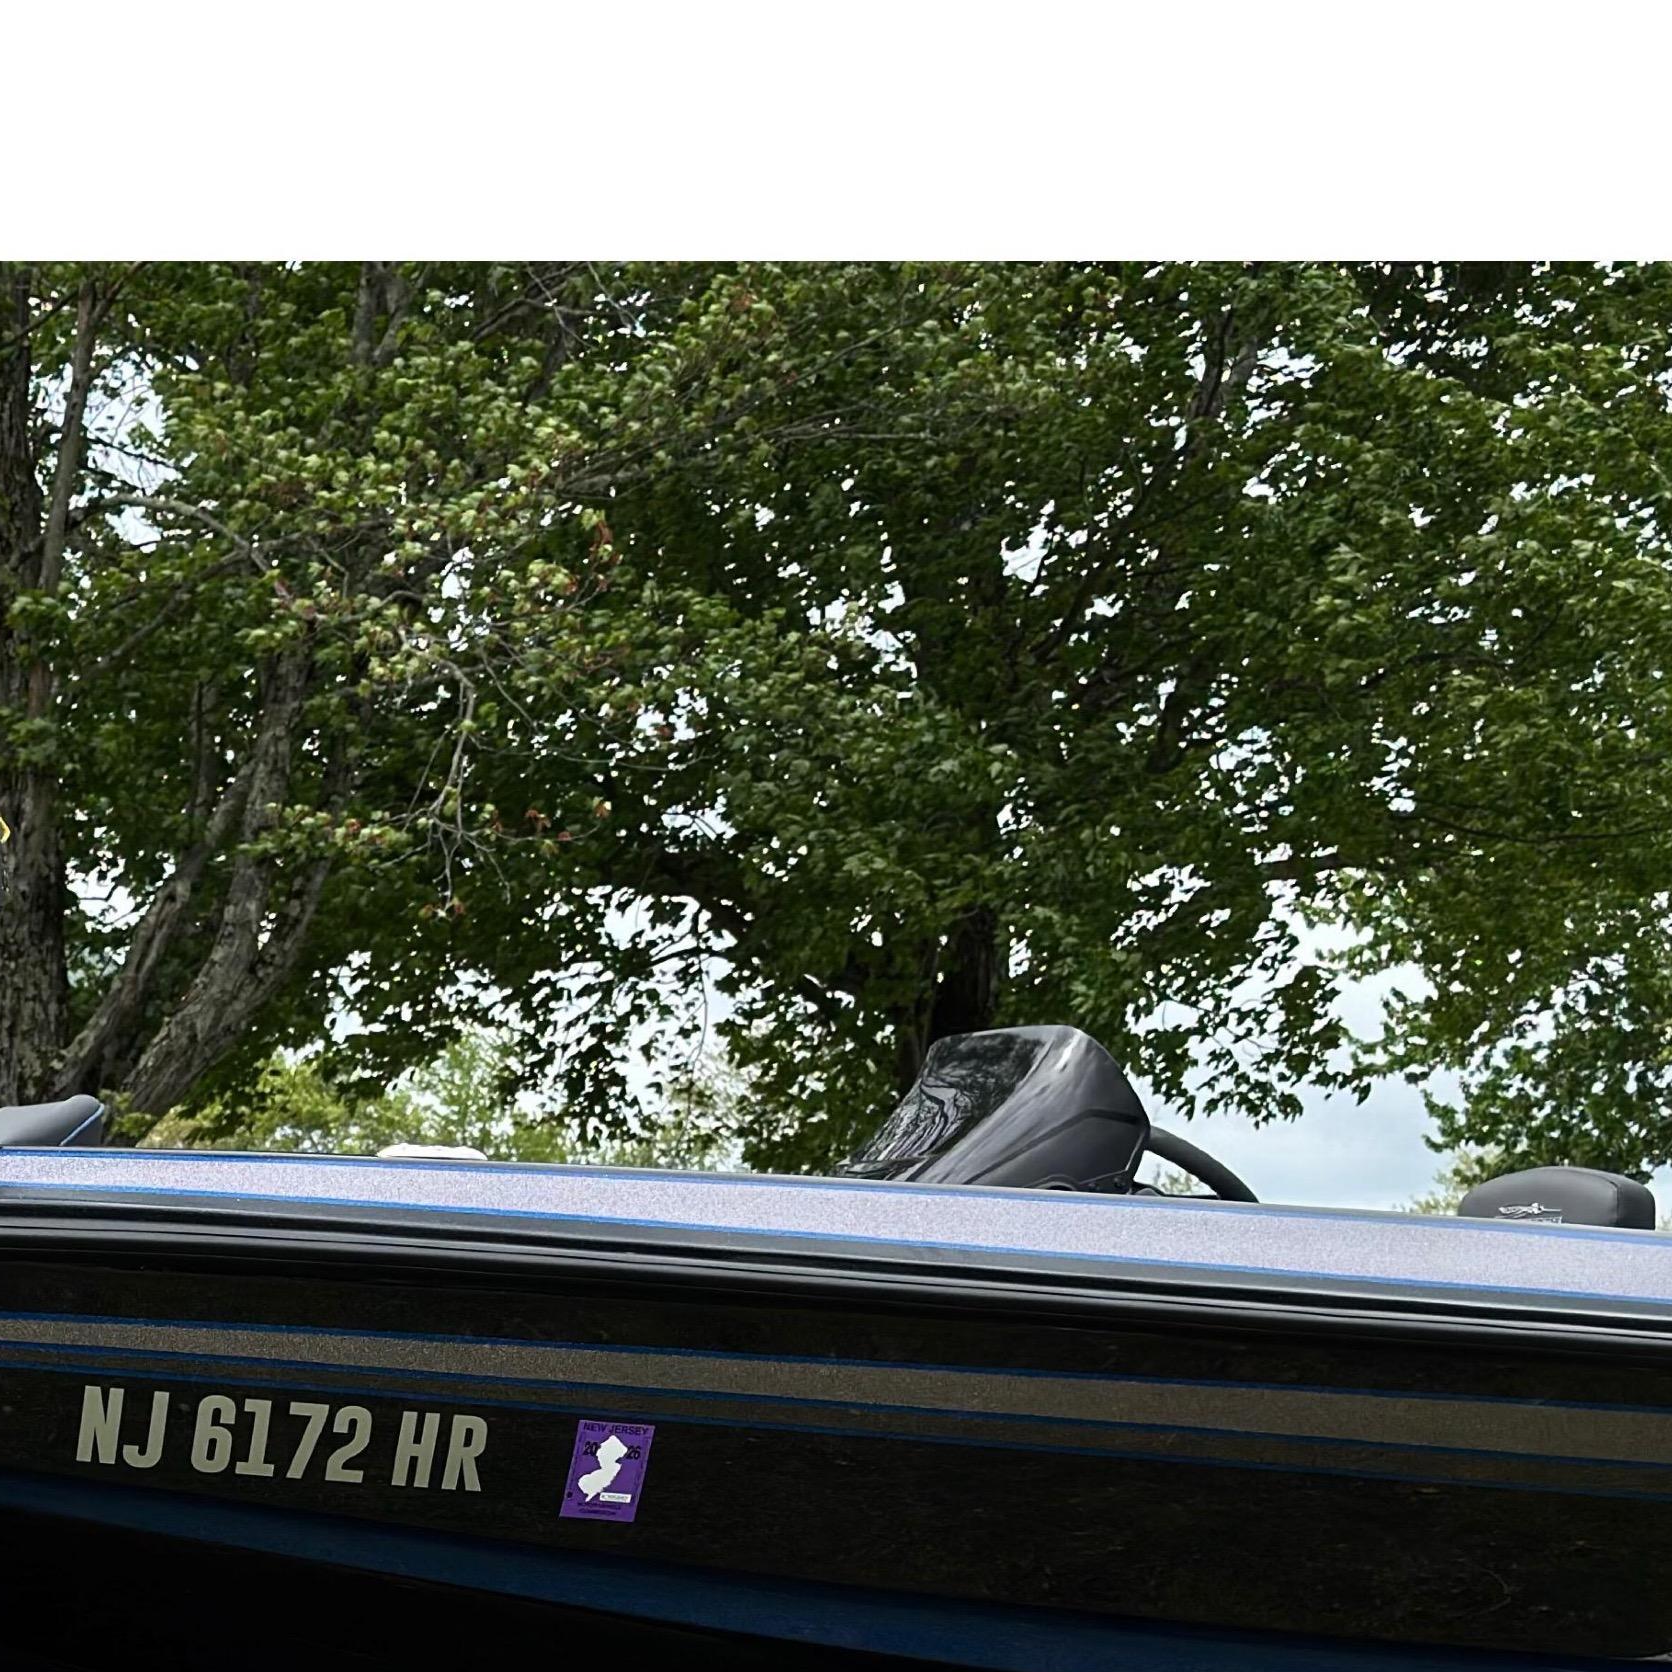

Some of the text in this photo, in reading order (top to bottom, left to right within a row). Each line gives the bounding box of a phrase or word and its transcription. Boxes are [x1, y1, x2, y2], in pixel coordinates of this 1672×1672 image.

[76, 1385, 488, 1492] NJ 6172 HR
[583, 1422, 650, 1436] NEW JERSEY
